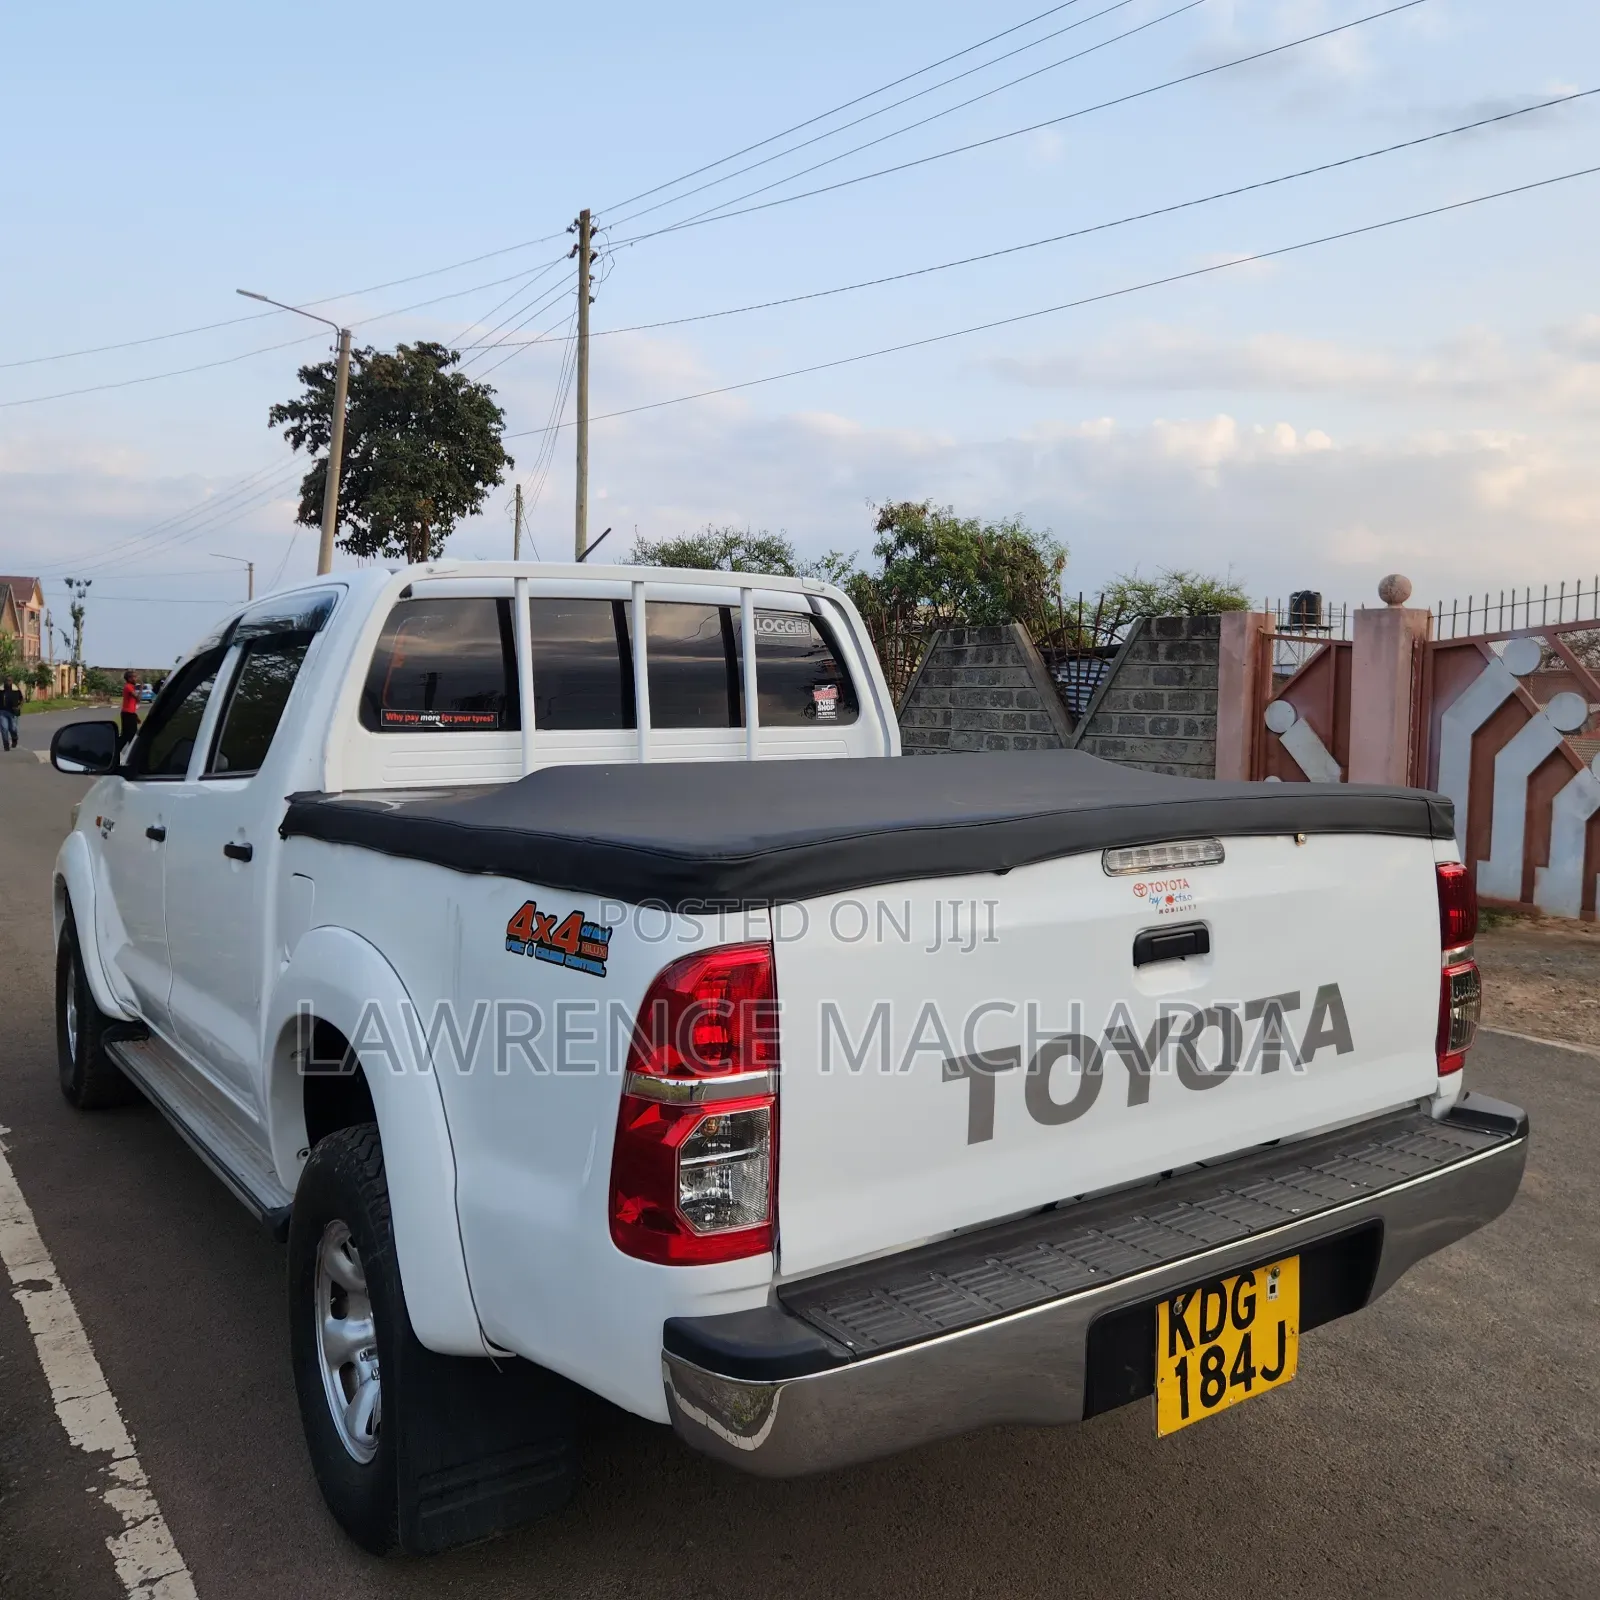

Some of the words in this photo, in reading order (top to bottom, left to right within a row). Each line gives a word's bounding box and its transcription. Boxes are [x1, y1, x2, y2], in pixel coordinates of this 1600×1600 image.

[756, 618, 810, 633] LOGGER
[817, 704, 836, 712] SHOP
[385, 712, 404, 723] Why
[404, 714, 420, 723] pay
[420, 714, 440, 722] more
[441, 713, 453, 723] for
[453, 715, 471, 724] your
[472, 715, 495, 724] tyres?
[1148, 879, 1189, 893] TOYOTA
[1158, 903, 1198, 915] MOBILITY
[506, 900, 585, 956] 4x4
[581, 941, 607, 959] HILUX
[941, 982, 1355, 1146] TOYOTA
[1168, 1270, 1257, 1359] KDG
[1174, 1319, 1287, 1421] 184J
